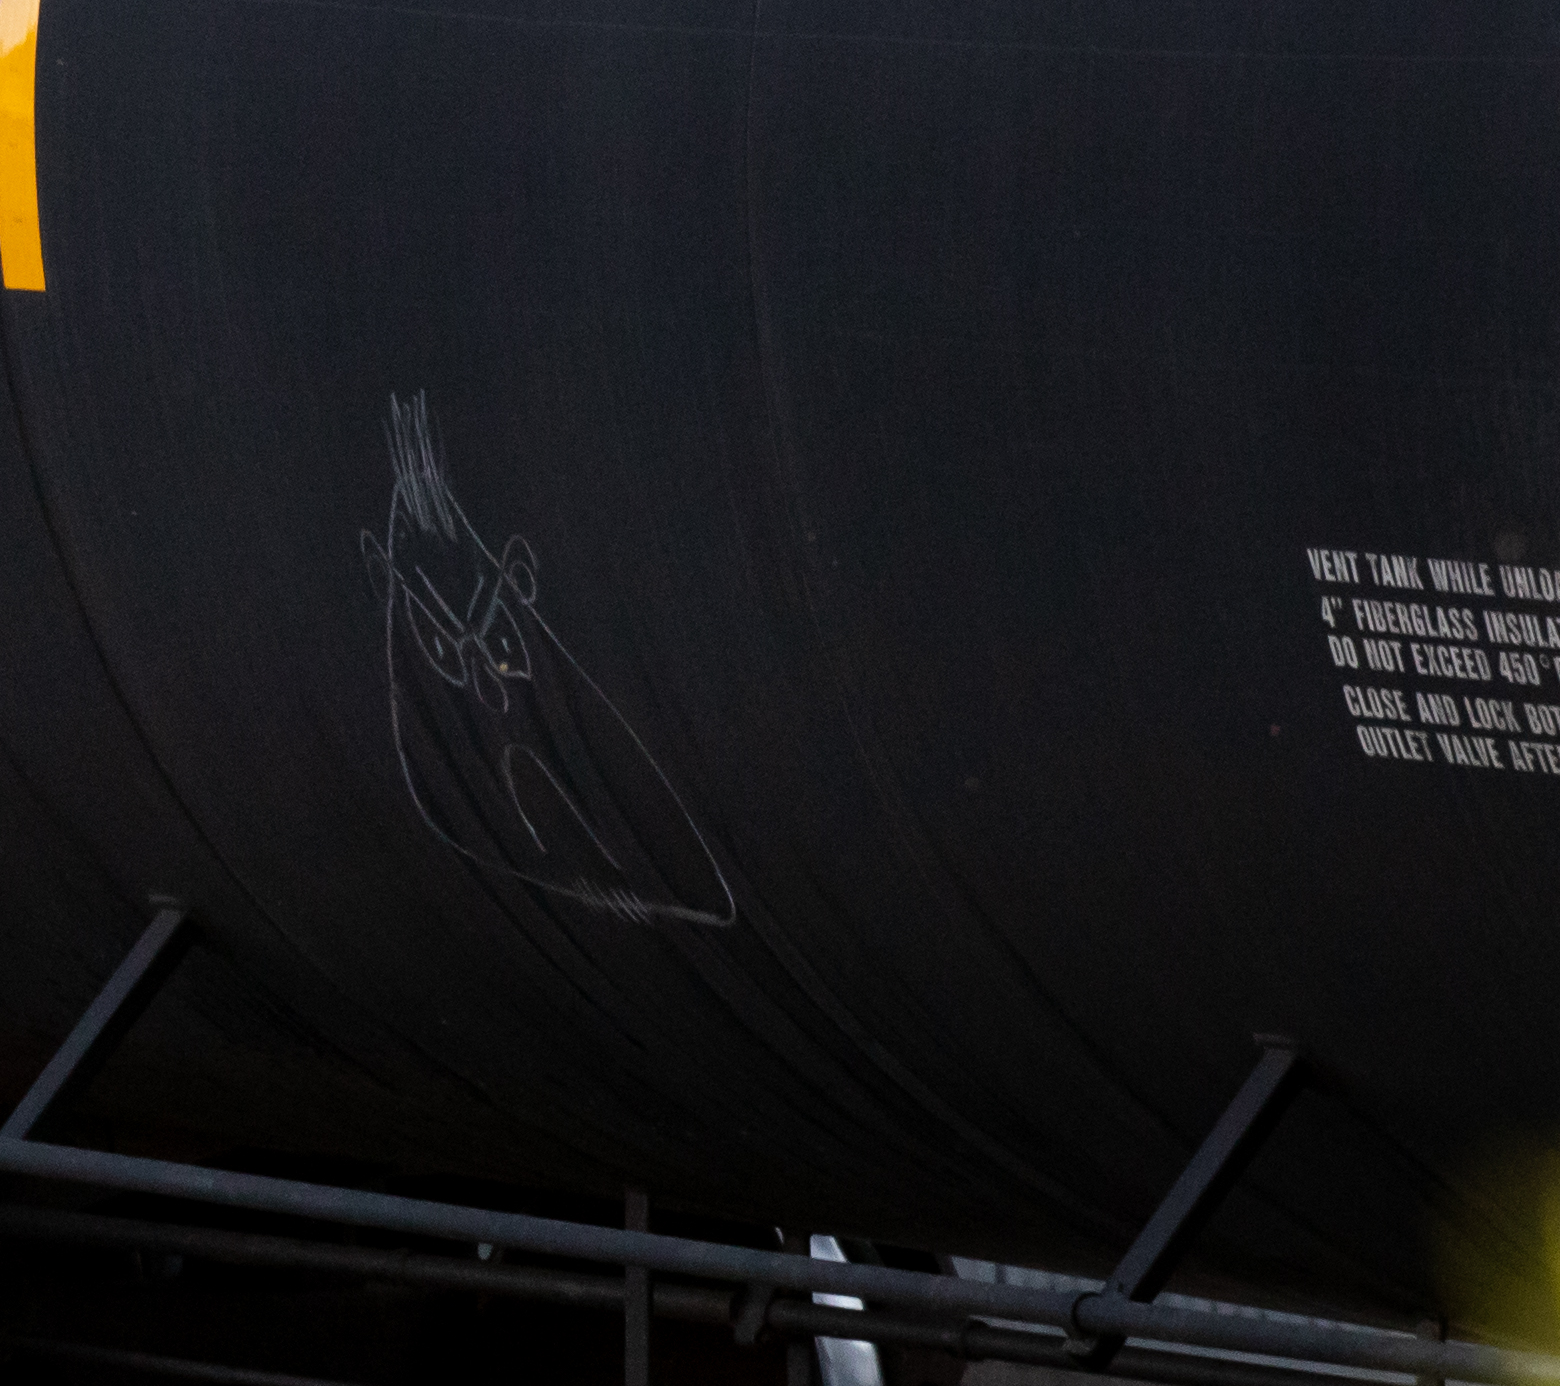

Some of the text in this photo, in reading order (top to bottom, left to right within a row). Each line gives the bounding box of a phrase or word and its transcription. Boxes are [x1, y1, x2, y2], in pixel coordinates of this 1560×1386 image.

[1306, 548, 1360, 584] VENT
[1364, 552, 1424, 591] TANK
[1426, 557, 1496, 597] WHILE
[1352, 597, 1479, 641] FIBERGLASS
[1327, 634, 1359, 670] DO
[1362, 637, 1405, 674] NOT
[1410, 642, 1492, 682] EXCEED
[1343, 683, 1412, 722] CLOSE
[1416, 692, 1460, 727] AND
[1463, 696, 1522, 733] LOCK
[1356, 724, 1560, 775] OUTLET VALVE AFTE
